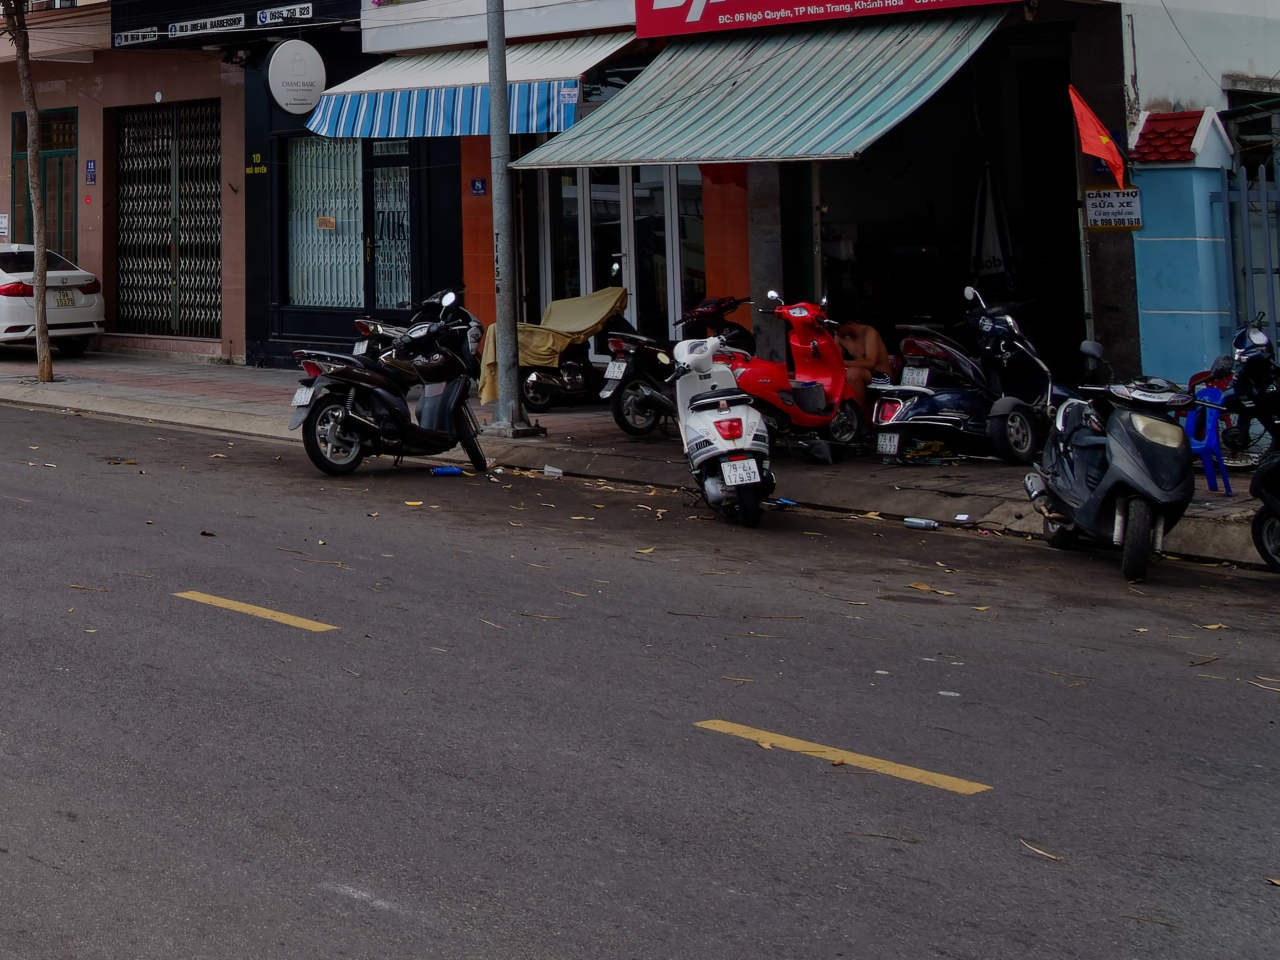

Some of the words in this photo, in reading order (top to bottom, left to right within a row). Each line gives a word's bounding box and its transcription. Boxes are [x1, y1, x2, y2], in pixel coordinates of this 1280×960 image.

[718, 14, 733, 25] ĐC:
[746, 10, 763, 25] Ngô
[794, 6, 806, 17] TP
[808, 4, 825, 16] Nha
[826, 2, 853, 15] Trang,
[252, 153, 261, 163] 10
